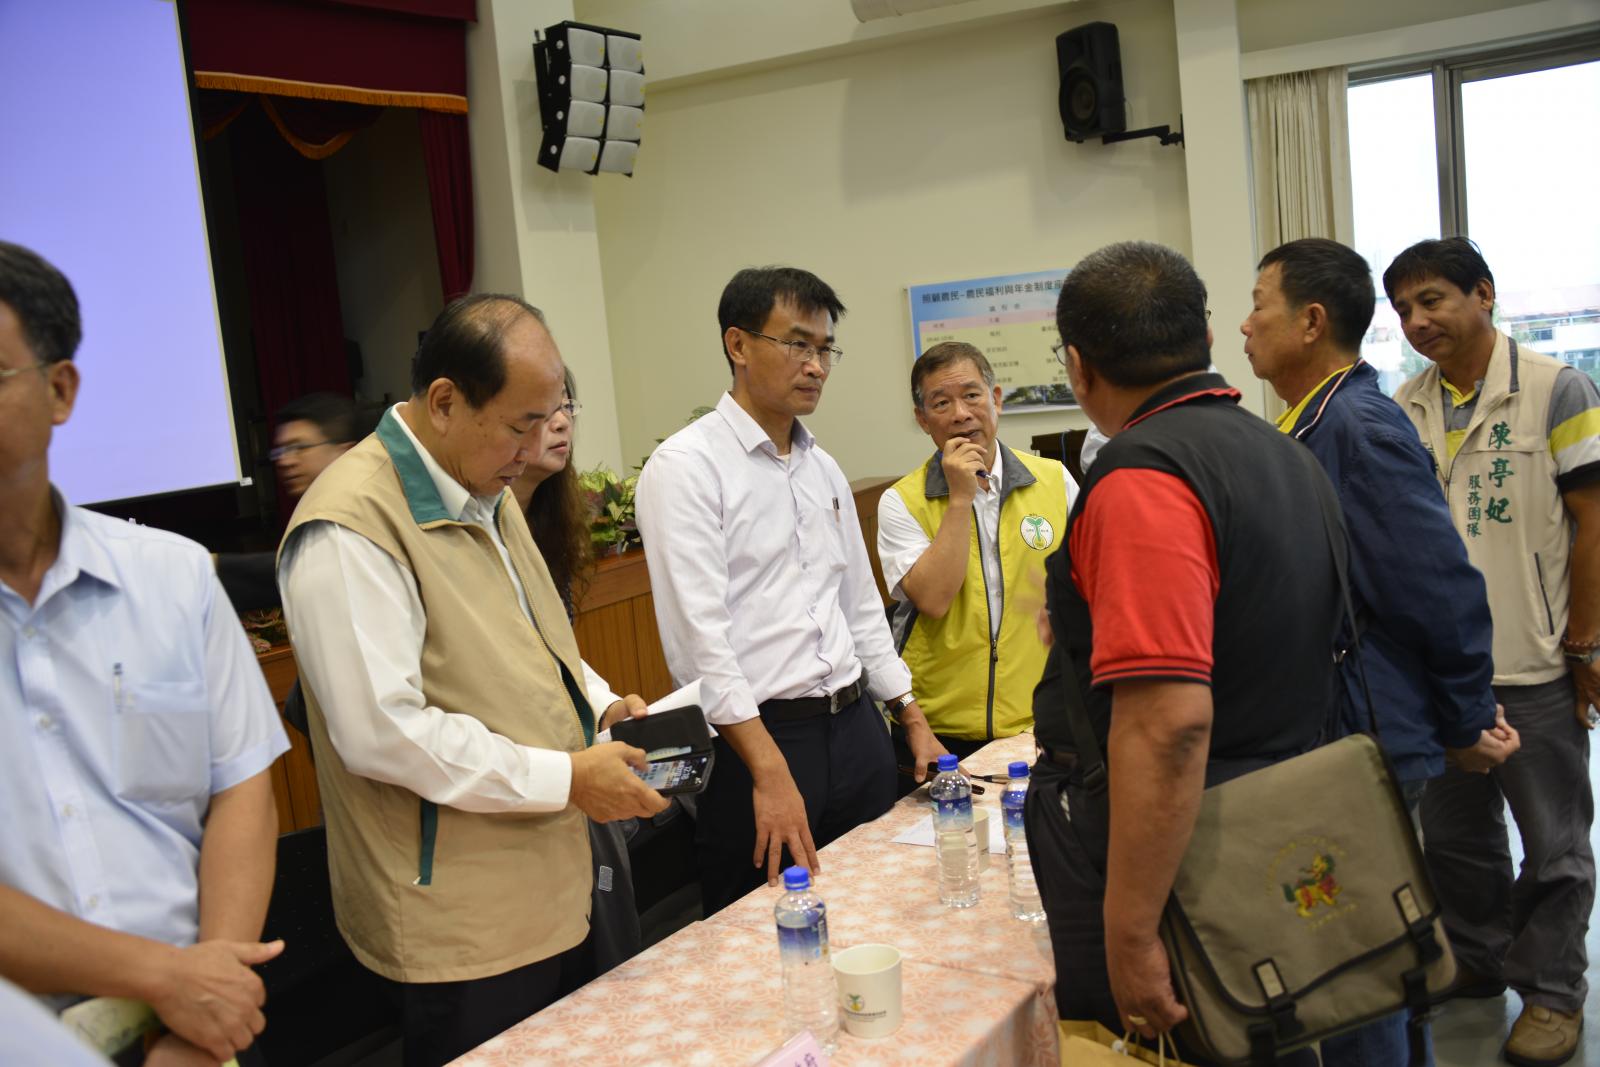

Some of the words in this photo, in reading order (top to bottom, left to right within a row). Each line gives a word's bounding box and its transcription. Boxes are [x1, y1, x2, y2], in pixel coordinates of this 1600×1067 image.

[1467, 474, 1482, 537] 服務團隊
[1485, 421, 1514, 523] 陳亭妃
